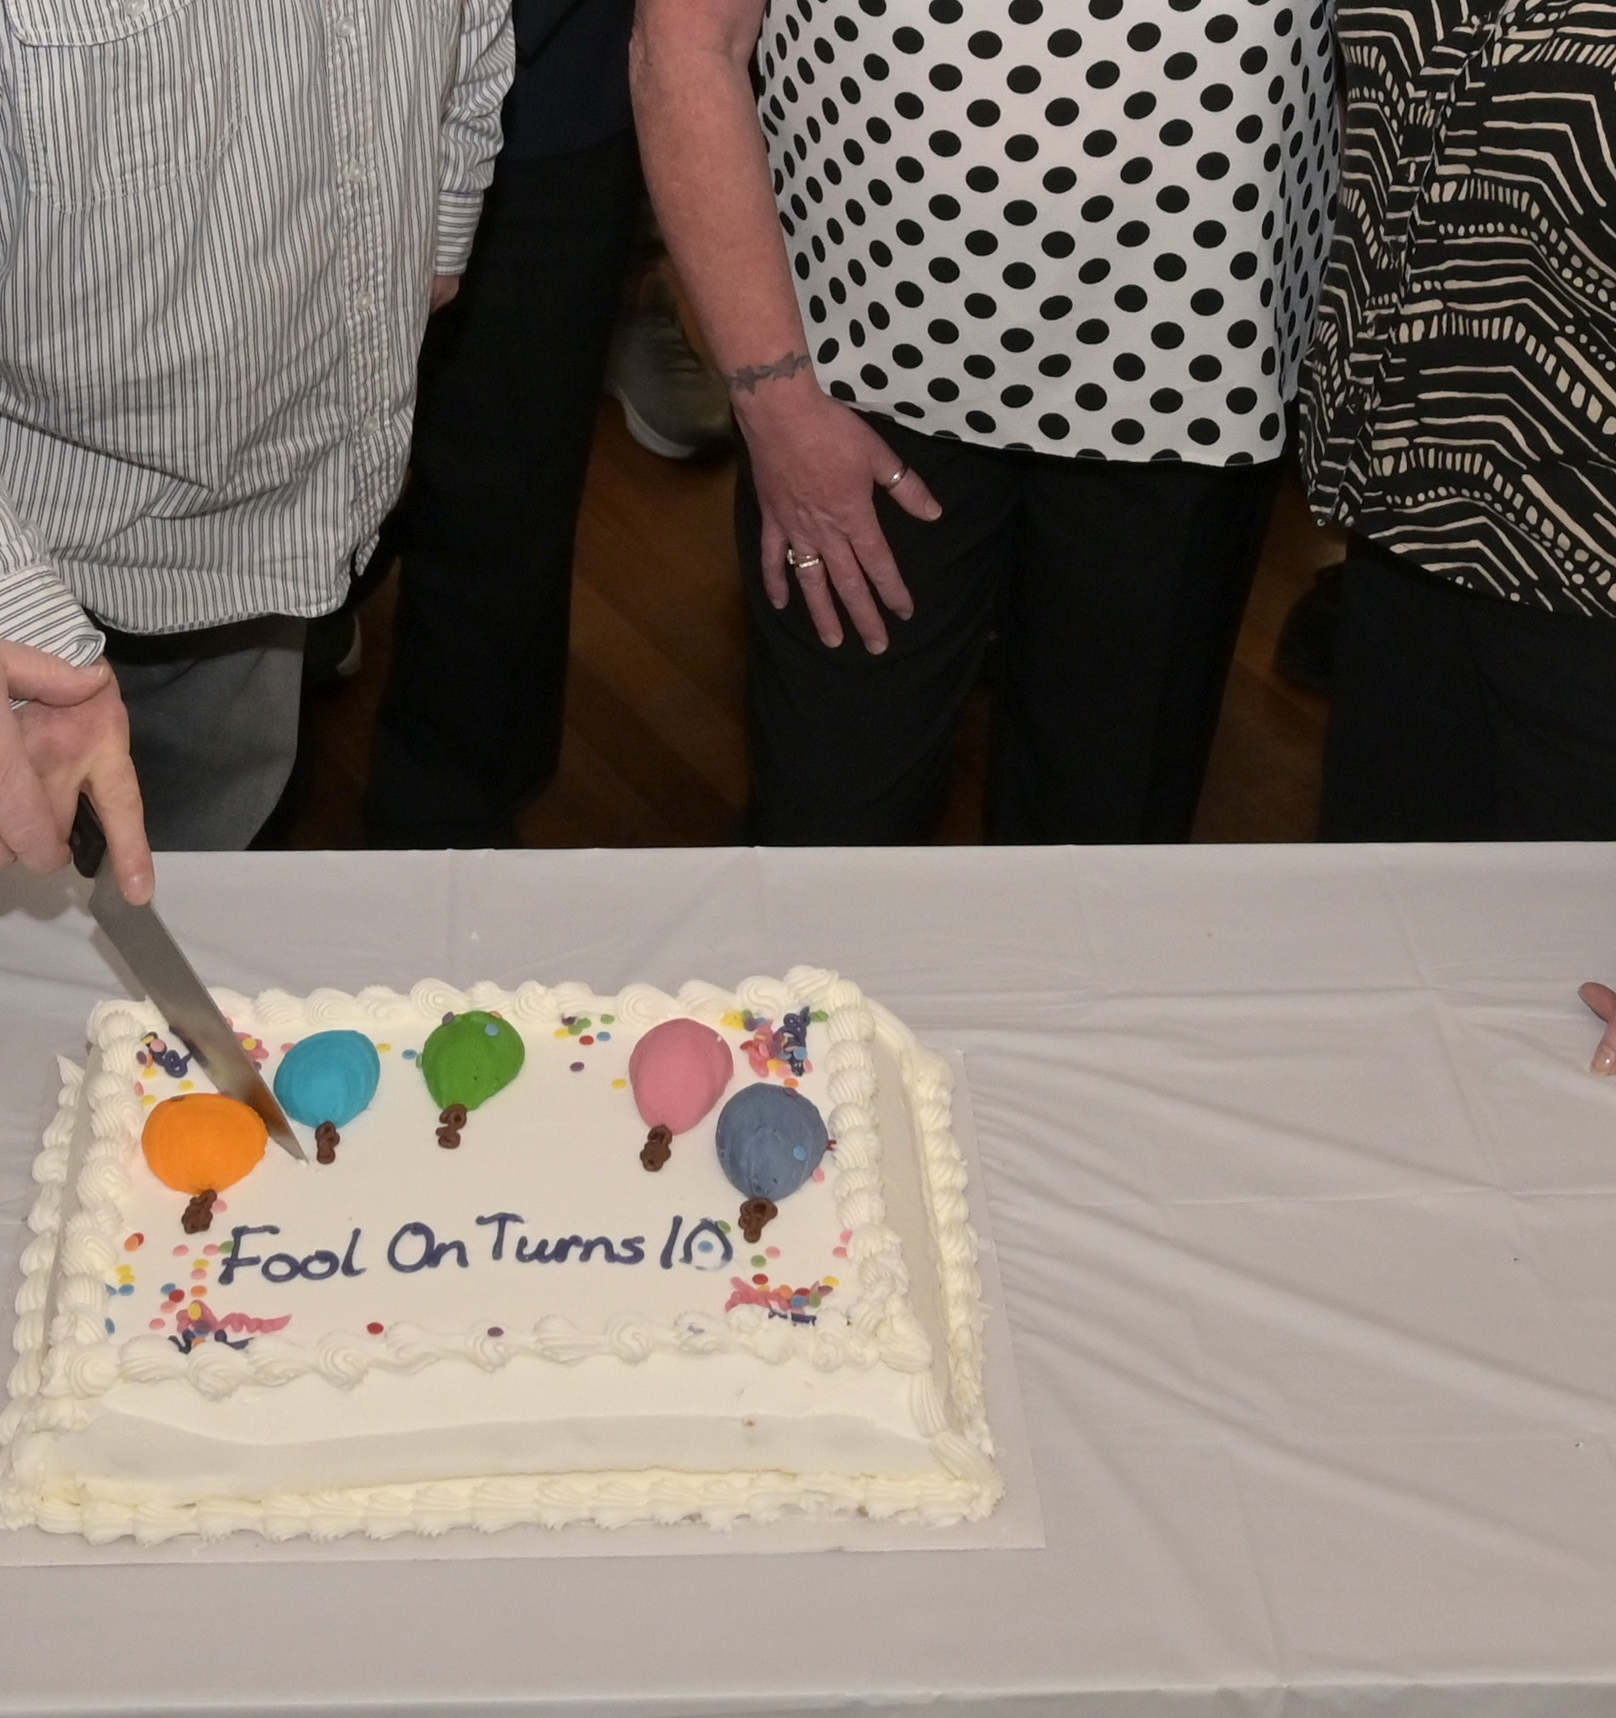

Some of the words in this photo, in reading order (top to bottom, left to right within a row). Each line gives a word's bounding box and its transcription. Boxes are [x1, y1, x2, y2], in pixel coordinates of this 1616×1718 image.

[217, 1225, 367, 1286] Fool
[386, 1221, 470, 1274] On
[474, 1211, 647, 1266] Turns
